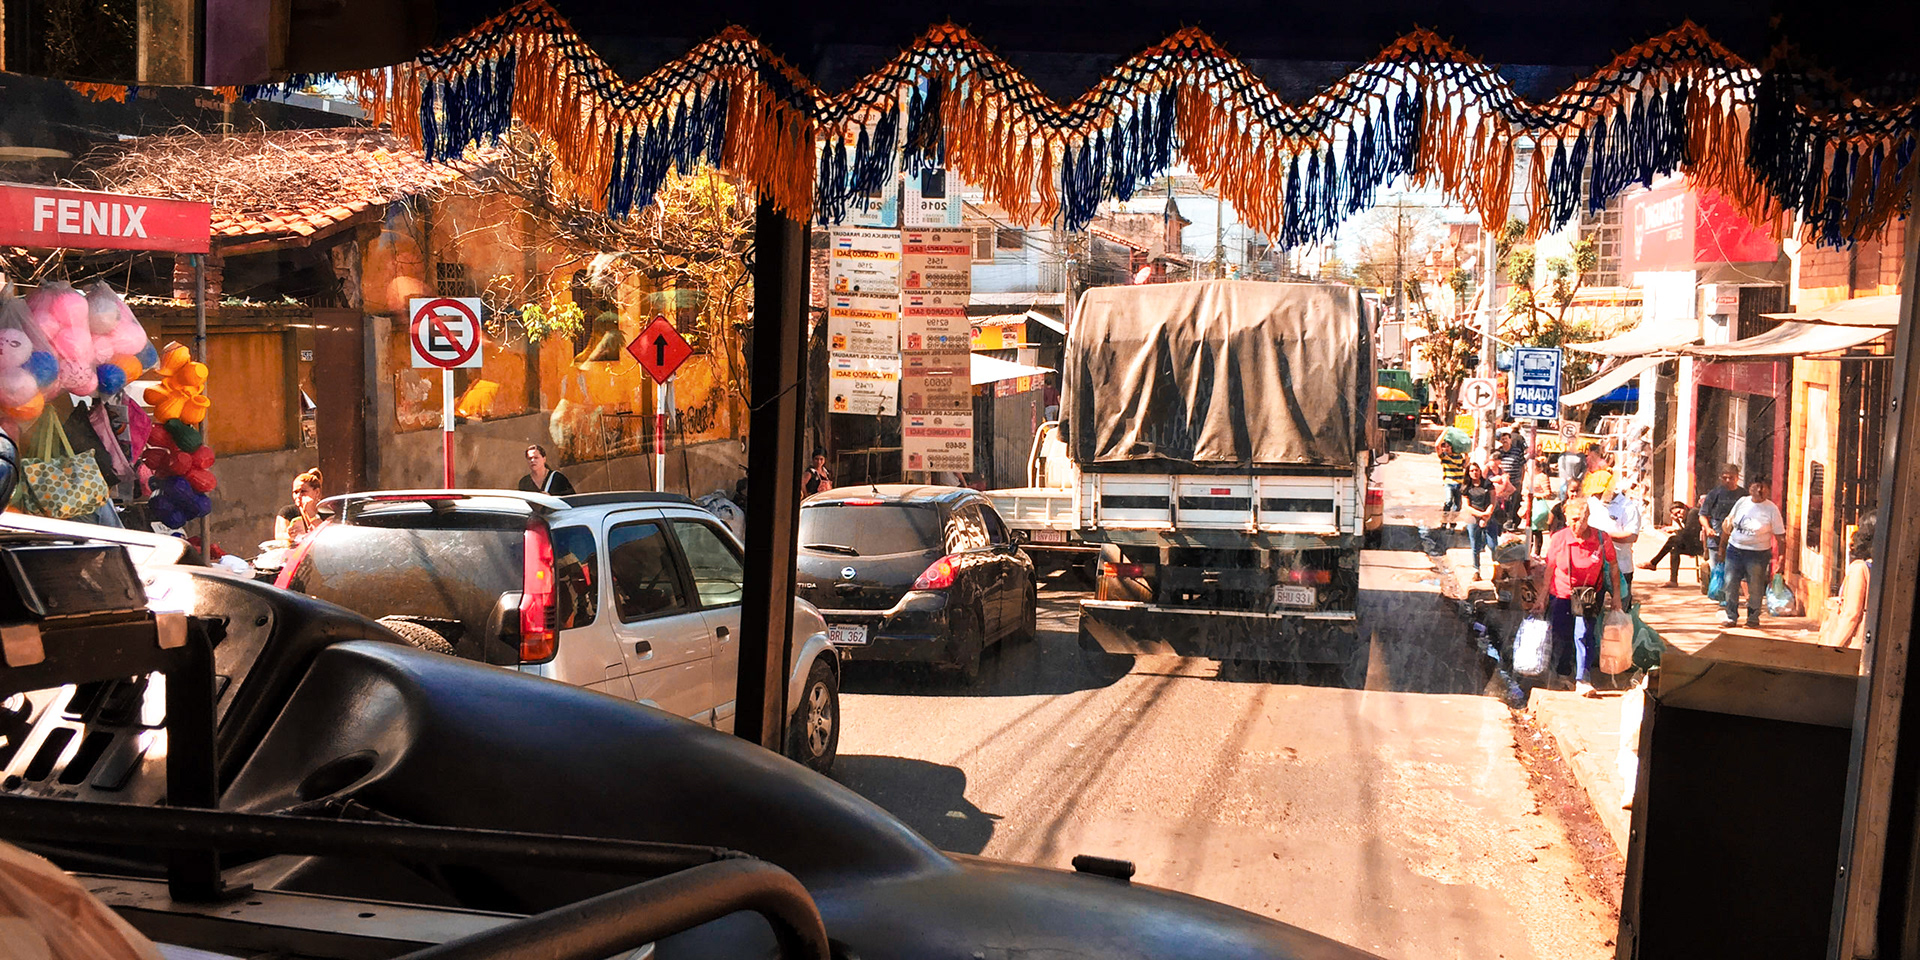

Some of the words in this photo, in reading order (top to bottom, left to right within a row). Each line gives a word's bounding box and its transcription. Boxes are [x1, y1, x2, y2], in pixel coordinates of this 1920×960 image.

[33, 196, 148, 239] FENIX
[1515, 387, 1554, 401] PARADA
[1514, 402, 1555, 417] BUS
[829, 630, 844, 641] BRL
[847, 631, 864, 643] 362
